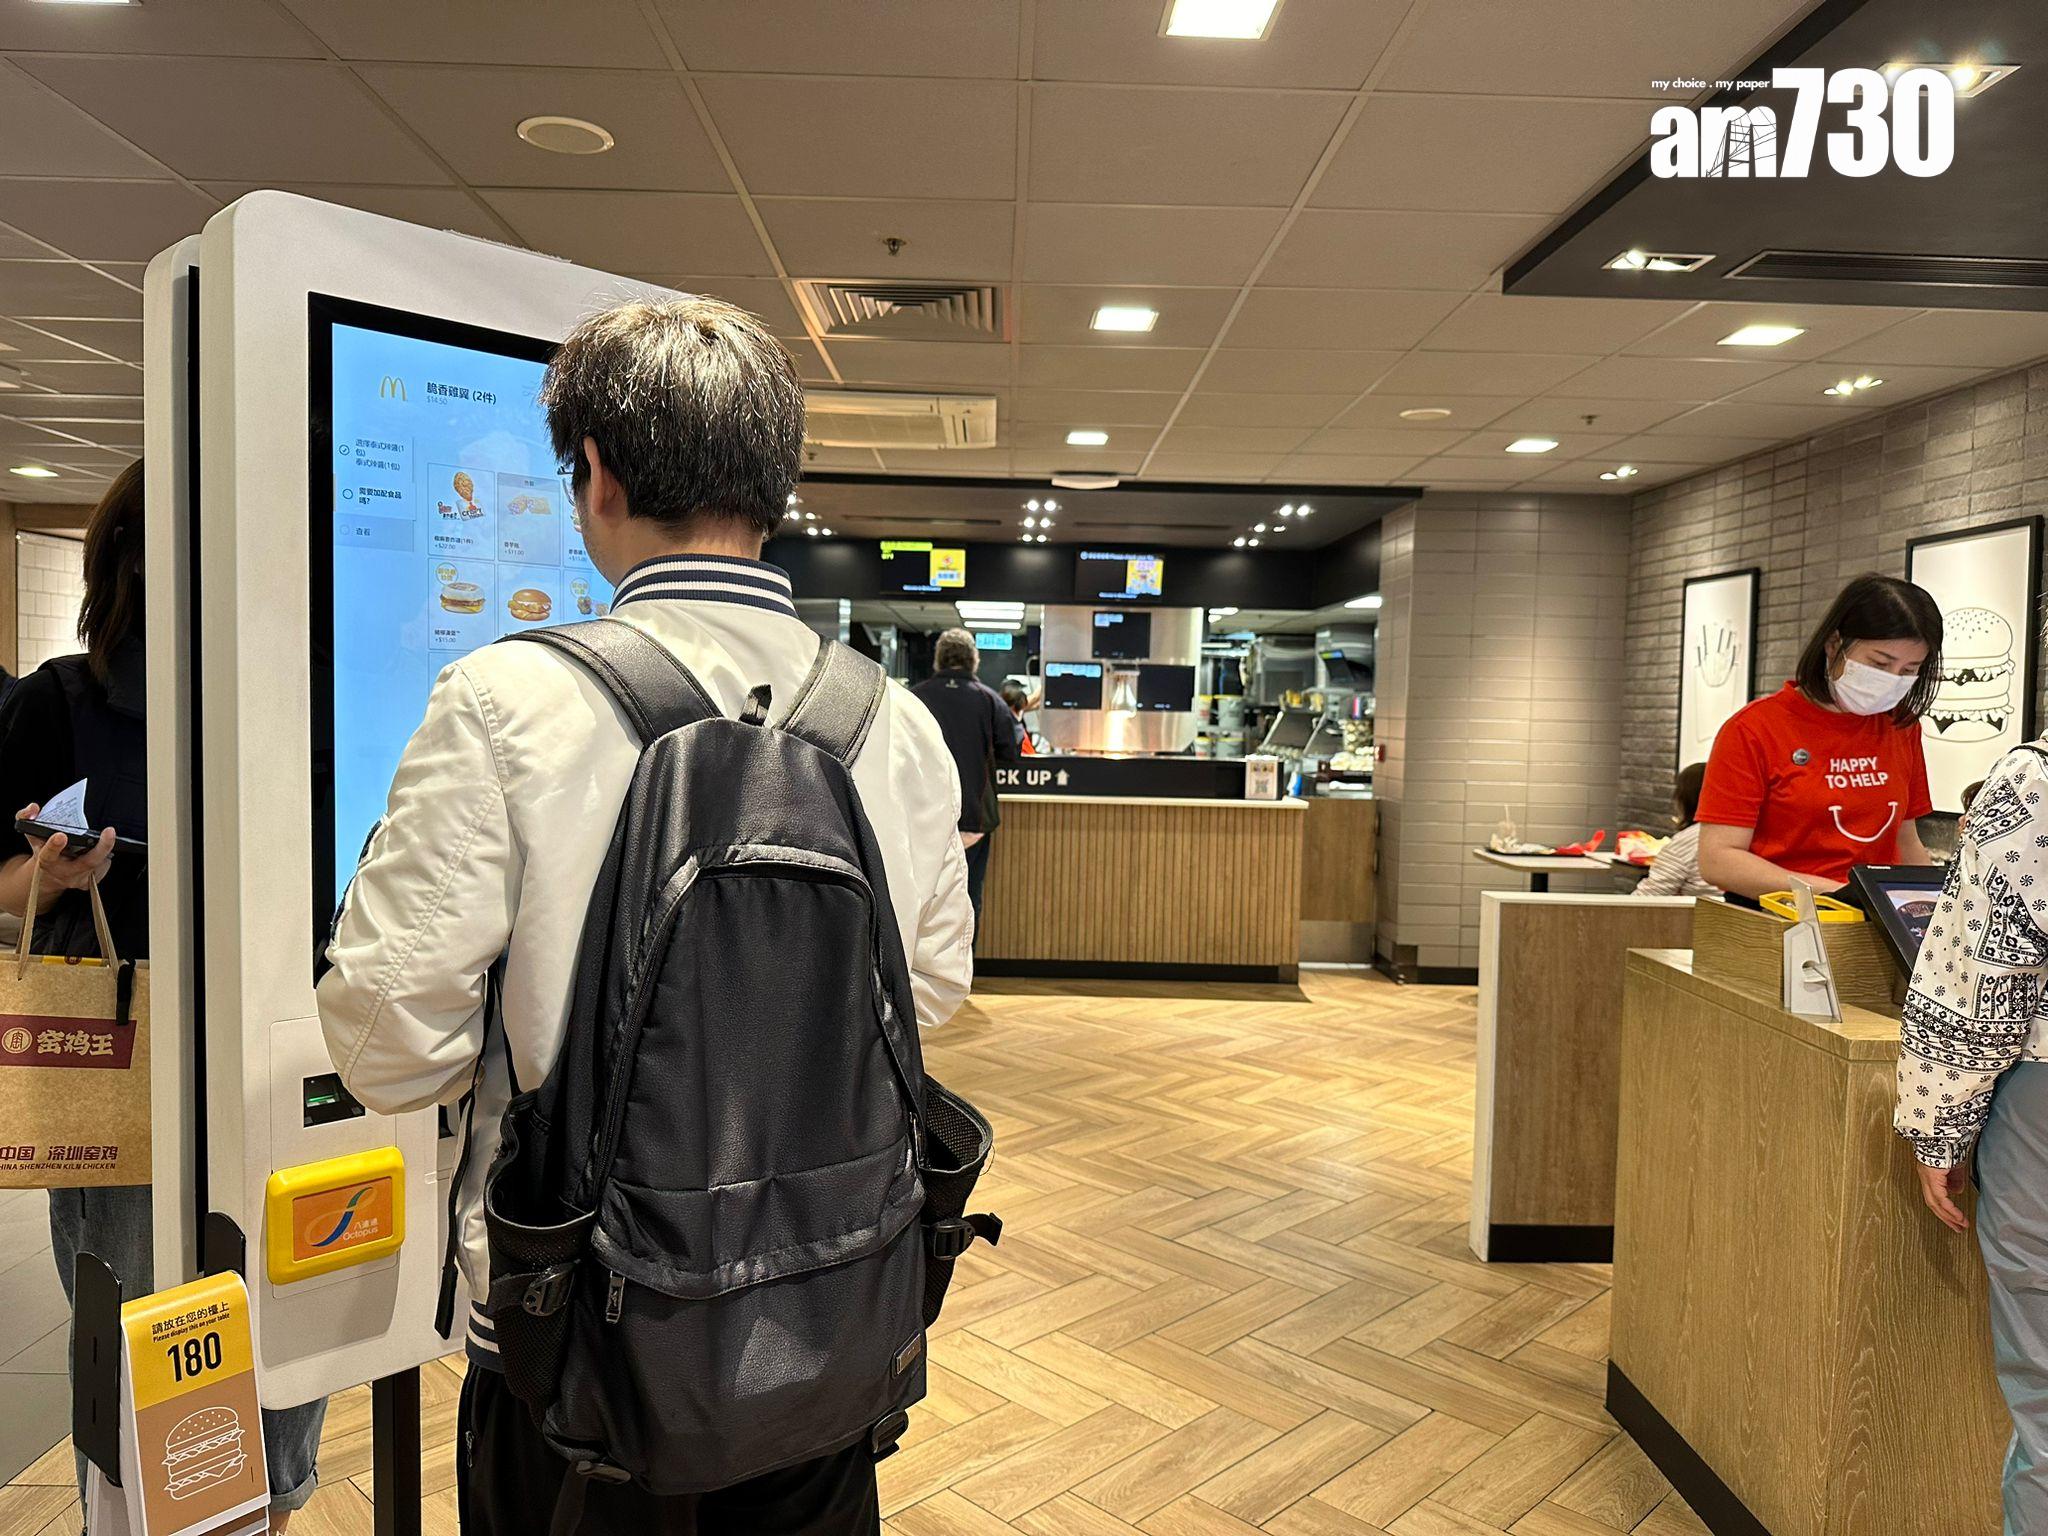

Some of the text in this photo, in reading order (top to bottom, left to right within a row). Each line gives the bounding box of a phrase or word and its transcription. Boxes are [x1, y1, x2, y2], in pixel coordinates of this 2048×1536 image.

[427, 382, 496, 405] 脆香雞翼 (2件)
[1830, 756, 1878, 773] HAPPY
[995, 769, 1052, 786] CK UP
[1825, 772, 1888, 789] TO HELP
[36, 1029, 114, 1056] 窑鸡王
[0, 1146, 118, 1161] 中国 深圳窑鸡
[19, 1162, 62, 1170] SHENZHEN
[82, 1162, 116, 1170] CHICKEN
[342, 1226, 379, 1241] Octopus
[151, 1301, 230, 1335] 請放在您的檯上
[153, 1333, 170, 1343] Please
[170, 1327, 188, 1337] display
[189, 1323, 199, 1331] this
[206, 1318, 218, 1327] your
[217, 1313, 230, 1321] table
[167, 1331, 222, 1383] 180
